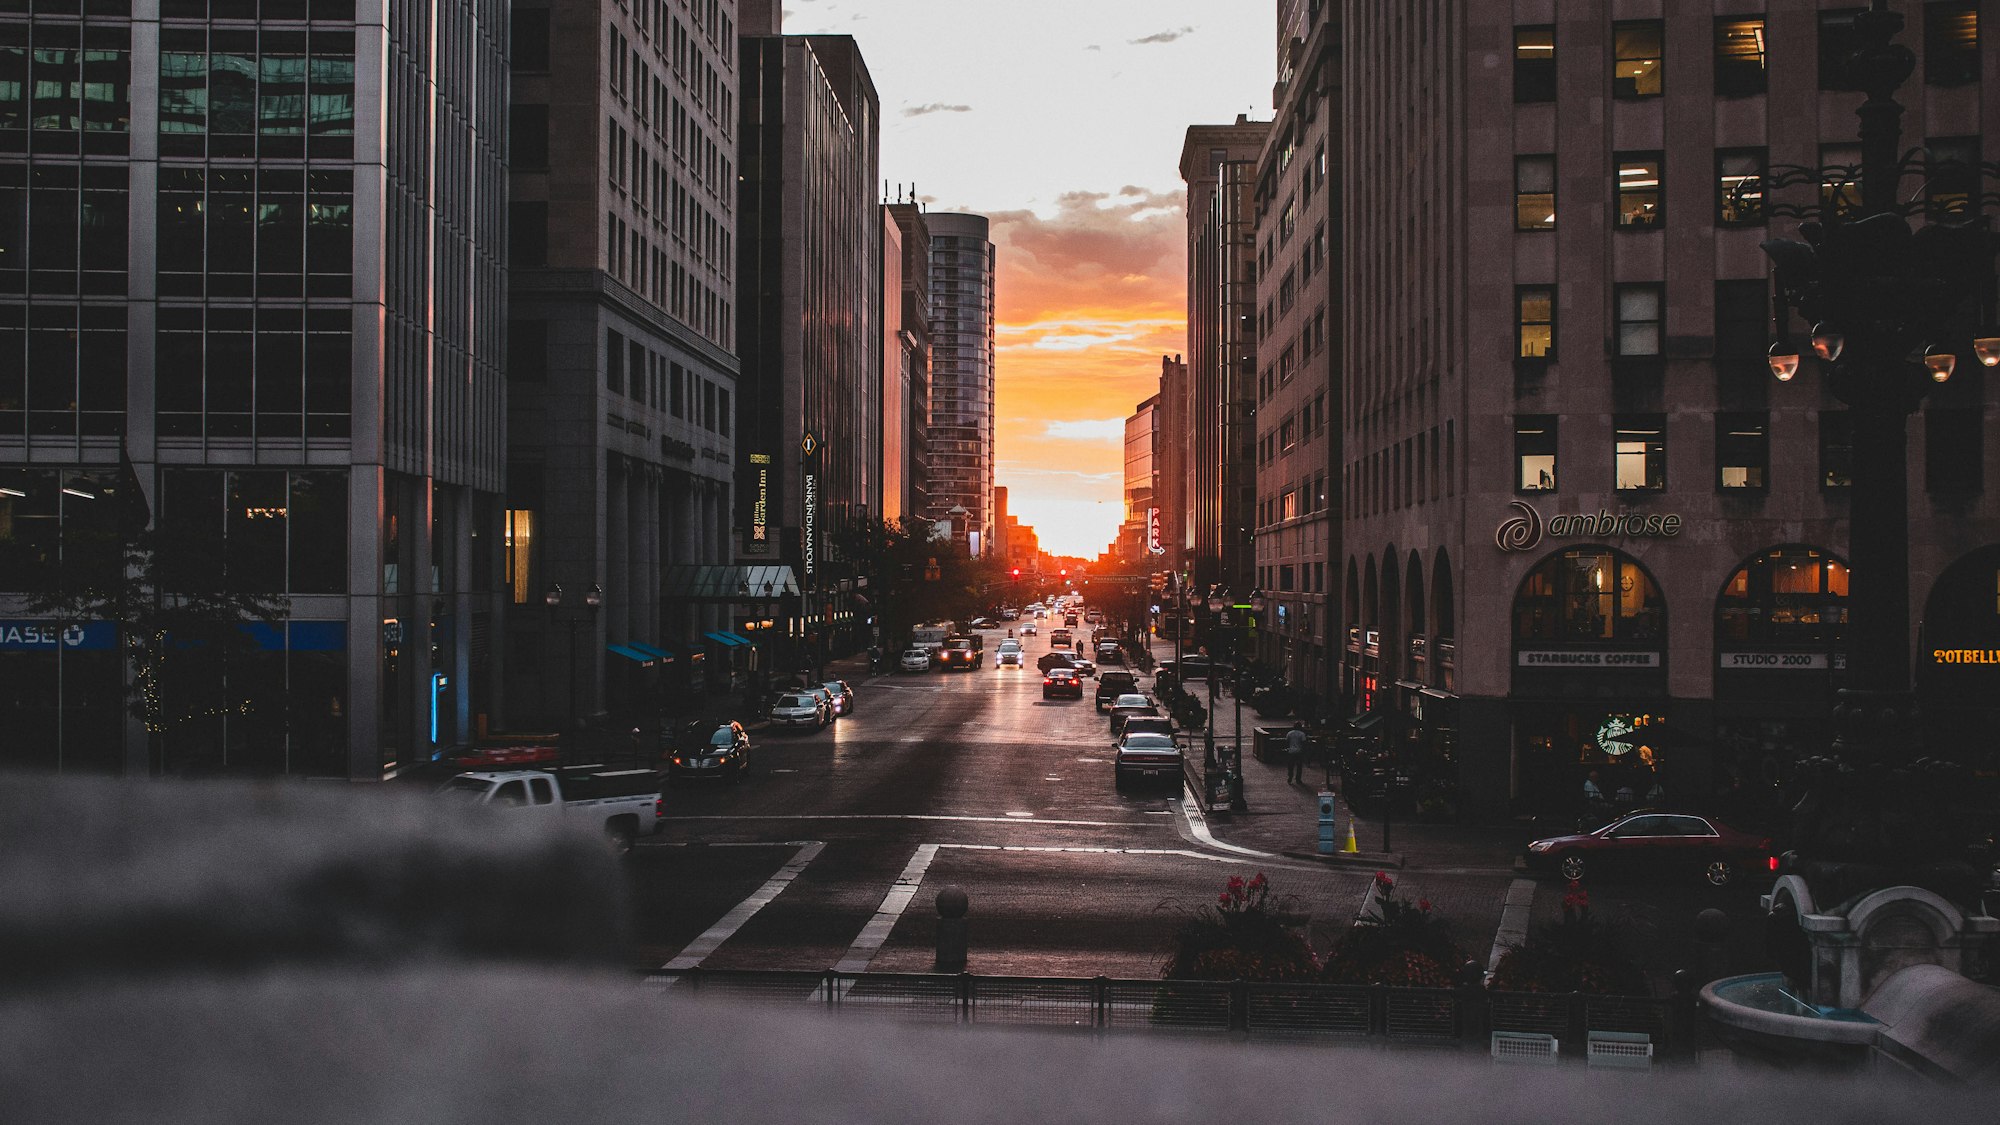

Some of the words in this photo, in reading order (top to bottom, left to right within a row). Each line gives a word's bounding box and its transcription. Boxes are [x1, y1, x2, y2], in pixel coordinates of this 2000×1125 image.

[759, 469, 767, 488] Inn
[1152, 507, 1160, 548] PARK
[1549, 509, 1681, 536] ambrose
[0, 626, 56, 643] ASE
[1527, 653, 1601, 664] STARBUCKS
[1605, 654, 1650, 664] COFFEE
[1733, 654, 1778, 665] STUDIO
[1782, 655, 1811, 665] 2000
